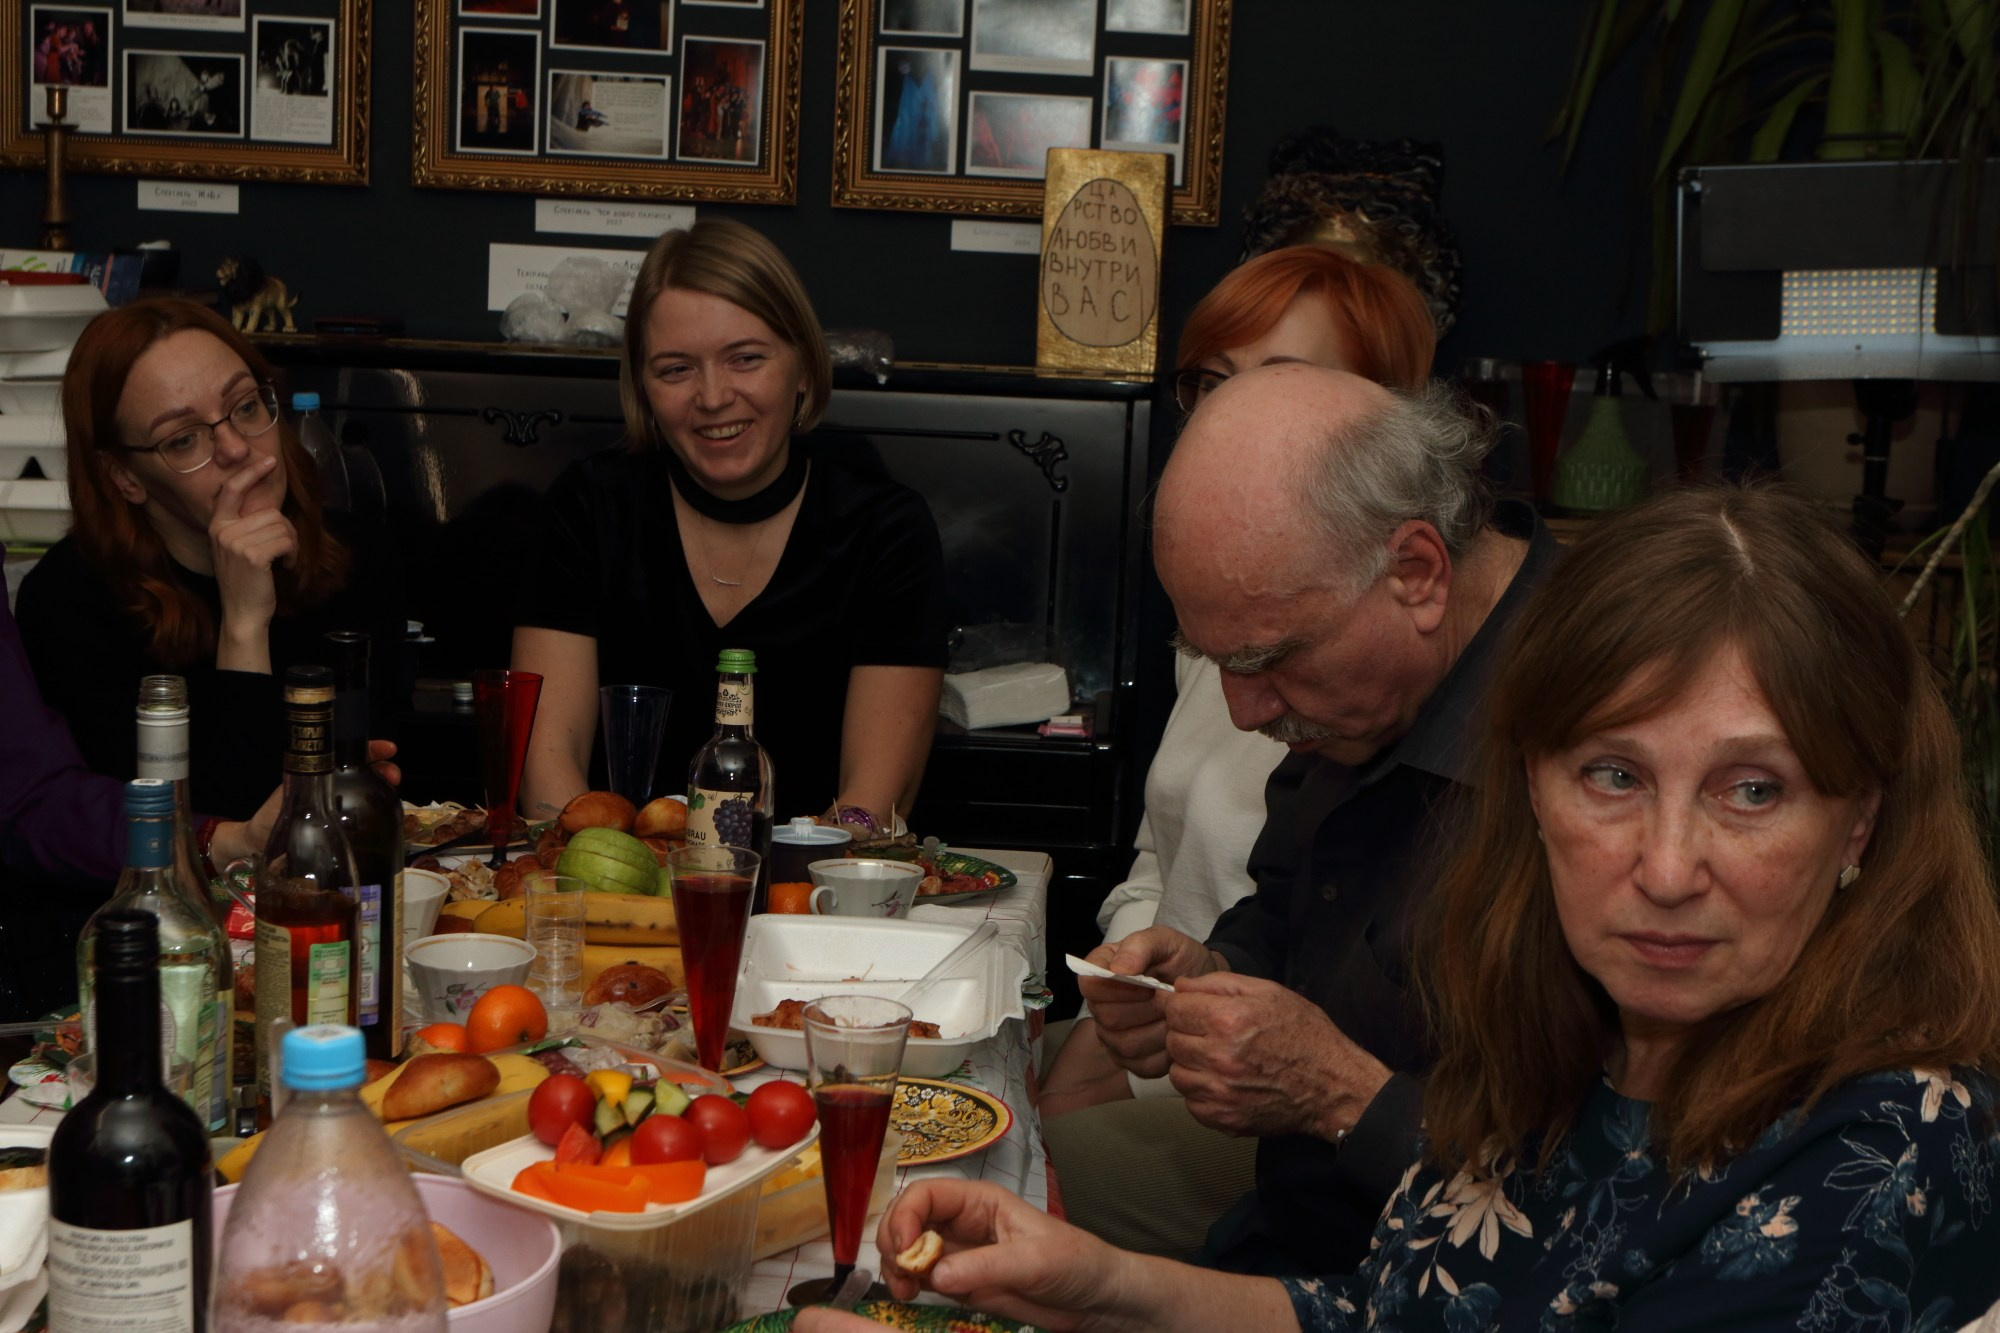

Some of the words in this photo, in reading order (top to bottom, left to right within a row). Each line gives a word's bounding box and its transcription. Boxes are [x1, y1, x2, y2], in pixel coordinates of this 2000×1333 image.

[1089, 183, 1116, 200] ЦА
[1074, 199, 1138, 225] РСТВО
[1053, 228, 1137, 255] ЛЮБВИ
[1050, 252, 1140, 286] ВНУТРИ
[1051, 283, 1130, 322] ВАС
